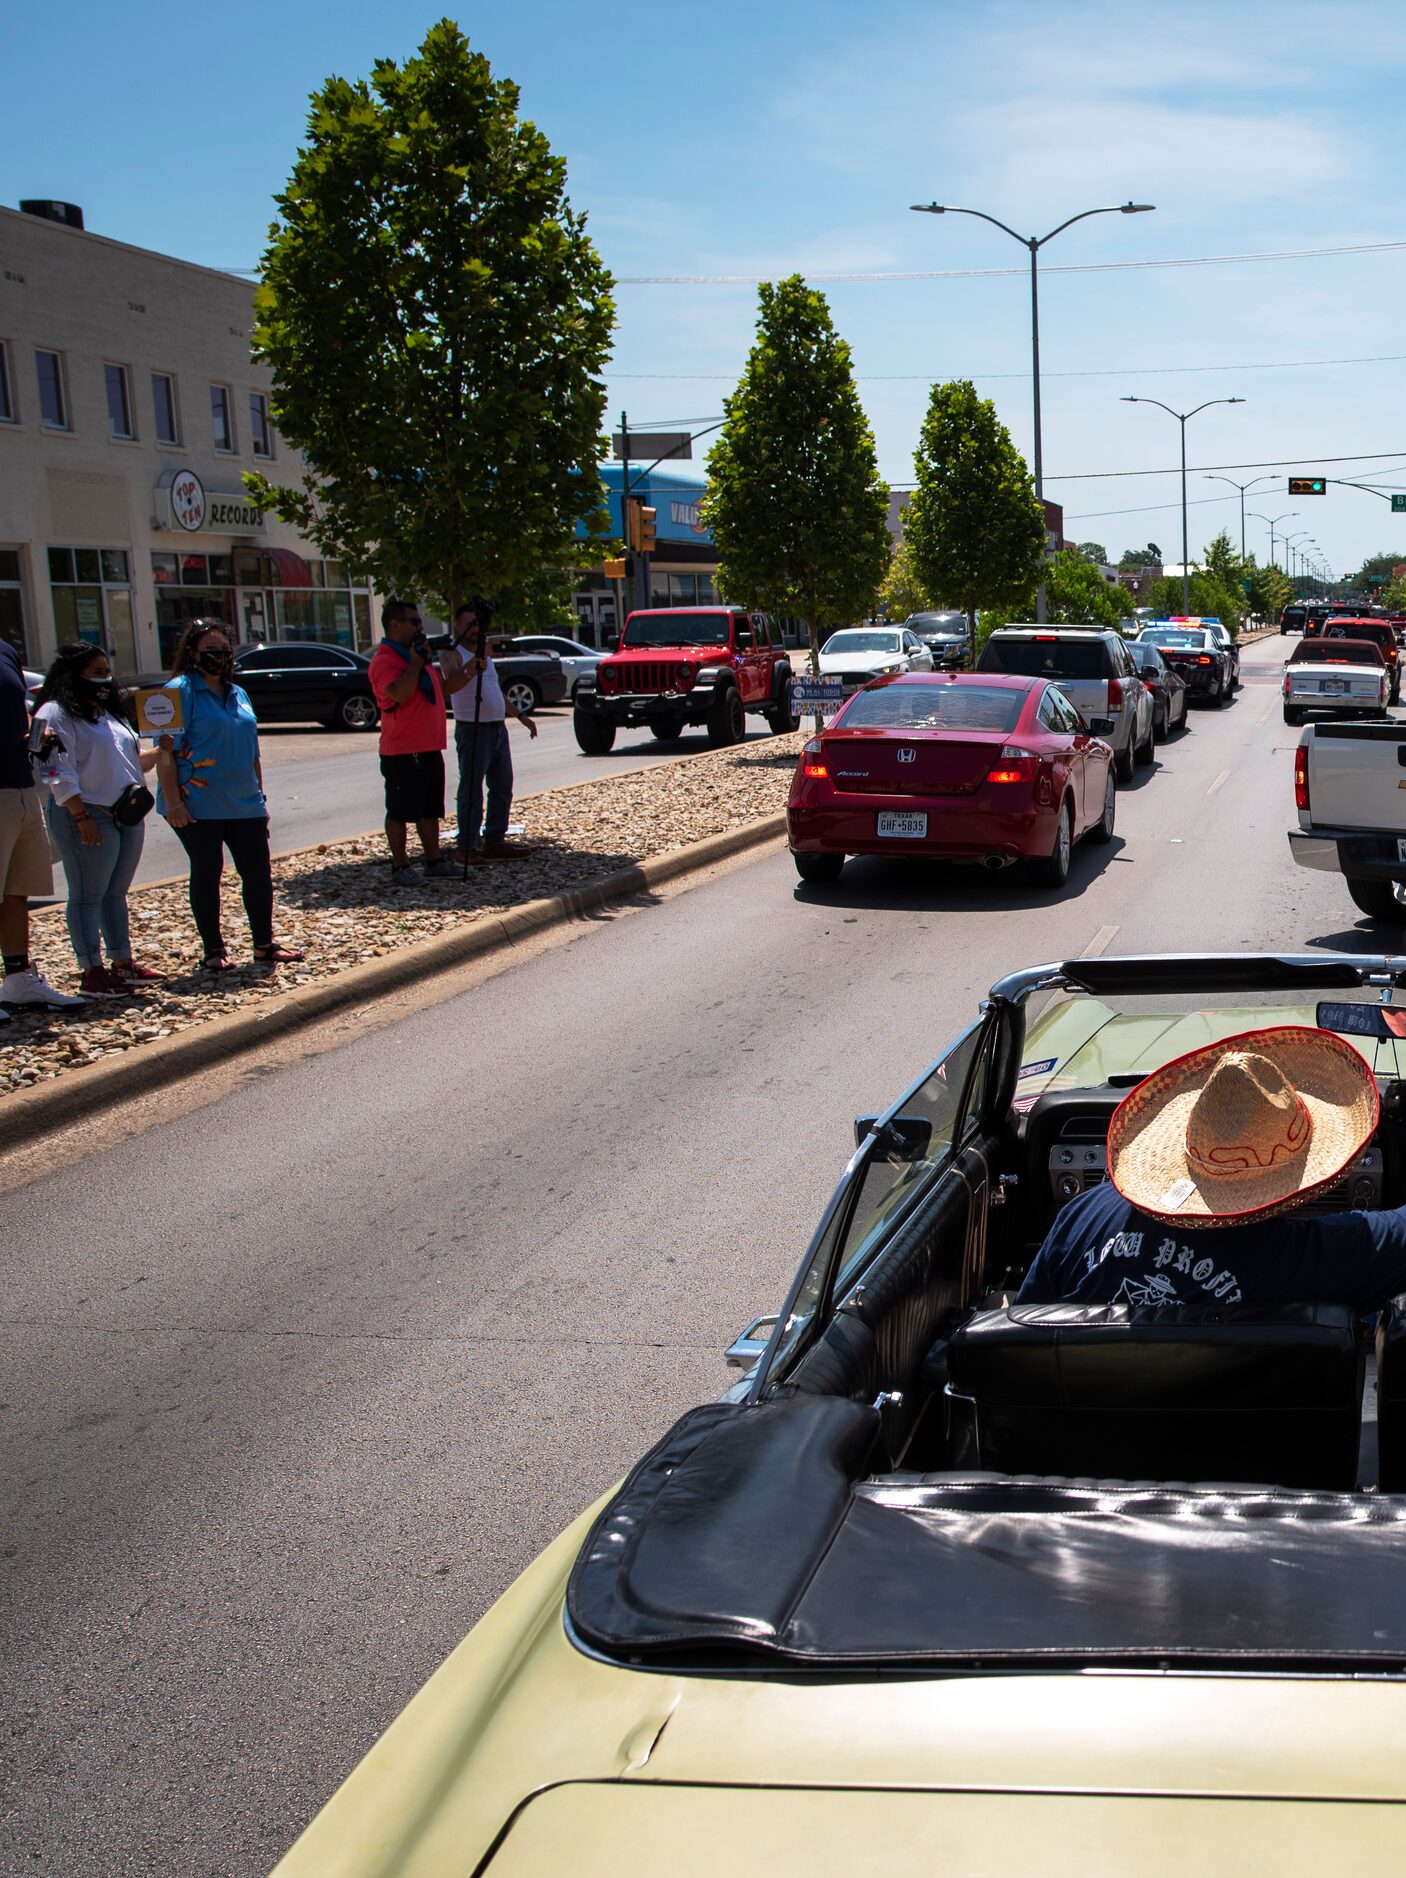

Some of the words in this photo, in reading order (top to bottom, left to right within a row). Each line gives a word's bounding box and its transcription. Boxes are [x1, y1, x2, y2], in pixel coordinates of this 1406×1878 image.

[176, 482, 195, 501] TOP
[182, 505, 201, 525] TEN
[211, 504, 264, 526] RECORDS
[1084, 1231, 1144, 1273] LOW
